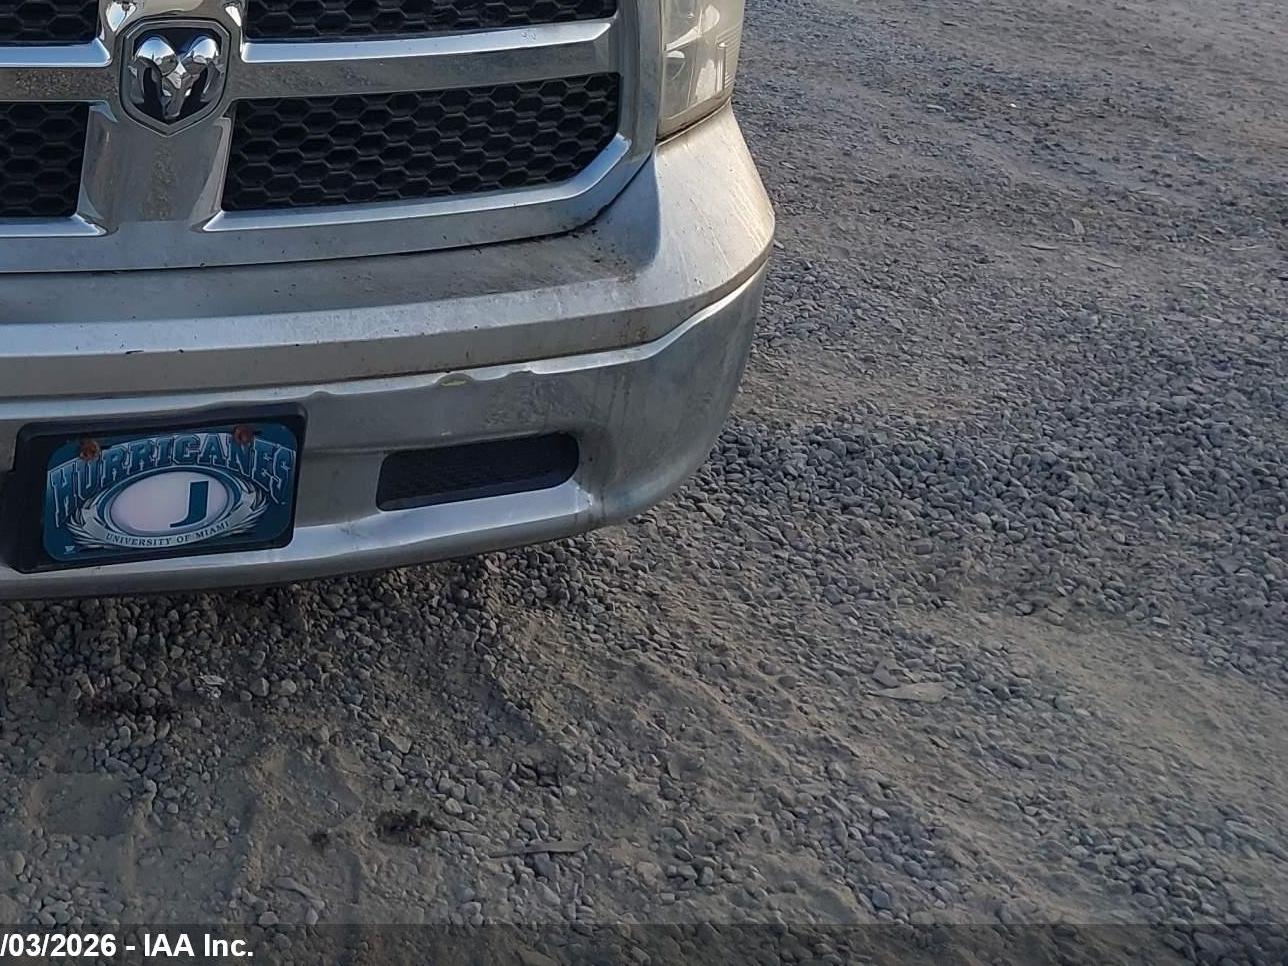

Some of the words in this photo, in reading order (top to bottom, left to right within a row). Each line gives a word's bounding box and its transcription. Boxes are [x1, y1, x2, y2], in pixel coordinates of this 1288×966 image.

[50, 433, 295, 528] HURRICANES
[105, 532, 173, 547] UNIVERSITY
[176, 534, 191, 544] OF
[195, 520, 230, 541] MIAMI
